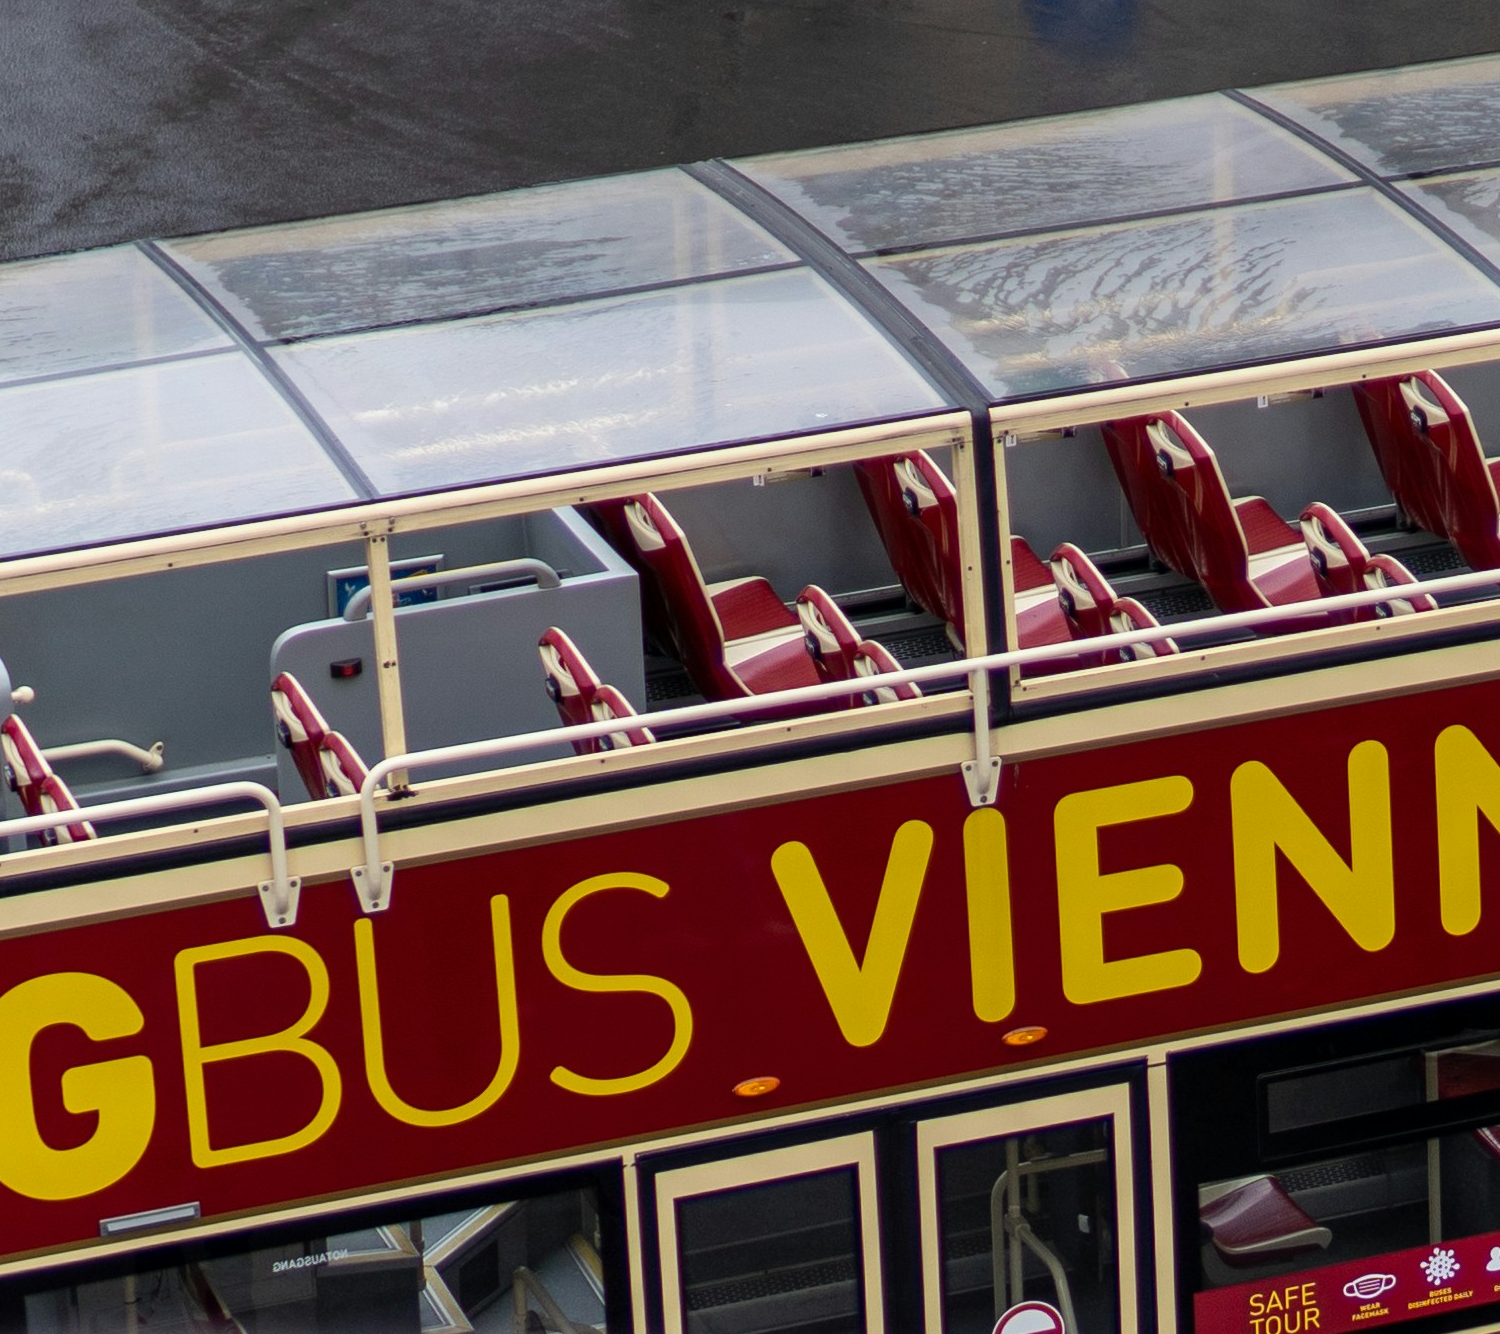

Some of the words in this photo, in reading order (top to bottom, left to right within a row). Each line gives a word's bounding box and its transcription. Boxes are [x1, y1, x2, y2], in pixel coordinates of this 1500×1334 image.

[1249, 1282, 1317, 1316] SAFE
[1359, 1302, 1381, 1312] WEAR
[1352, 1308, 1389, 1322] FACEMASK
